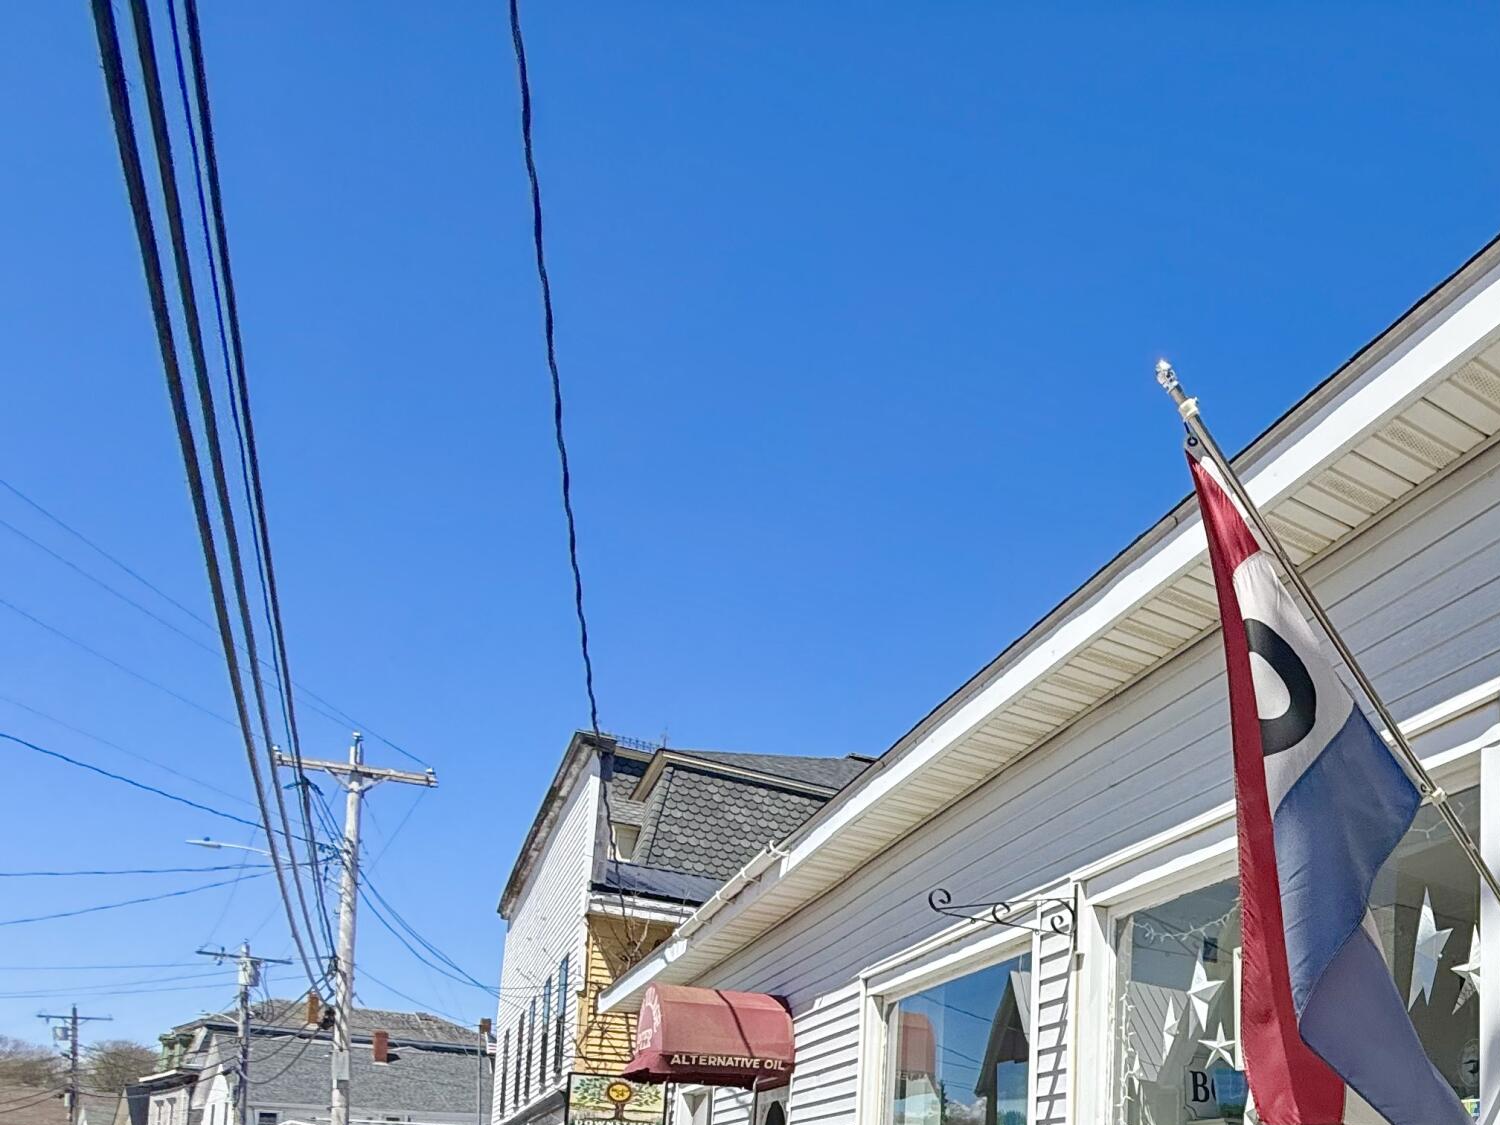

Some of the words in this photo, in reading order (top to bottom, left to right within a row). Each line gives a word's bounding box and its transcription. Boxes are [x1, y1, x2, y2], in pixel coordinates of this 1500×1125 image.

[670, 1054, 760, 1069] ALTERNATIVE
[764, 1059, 785, 1070] OIL
[1189, 1070, 1216, 1103] B
